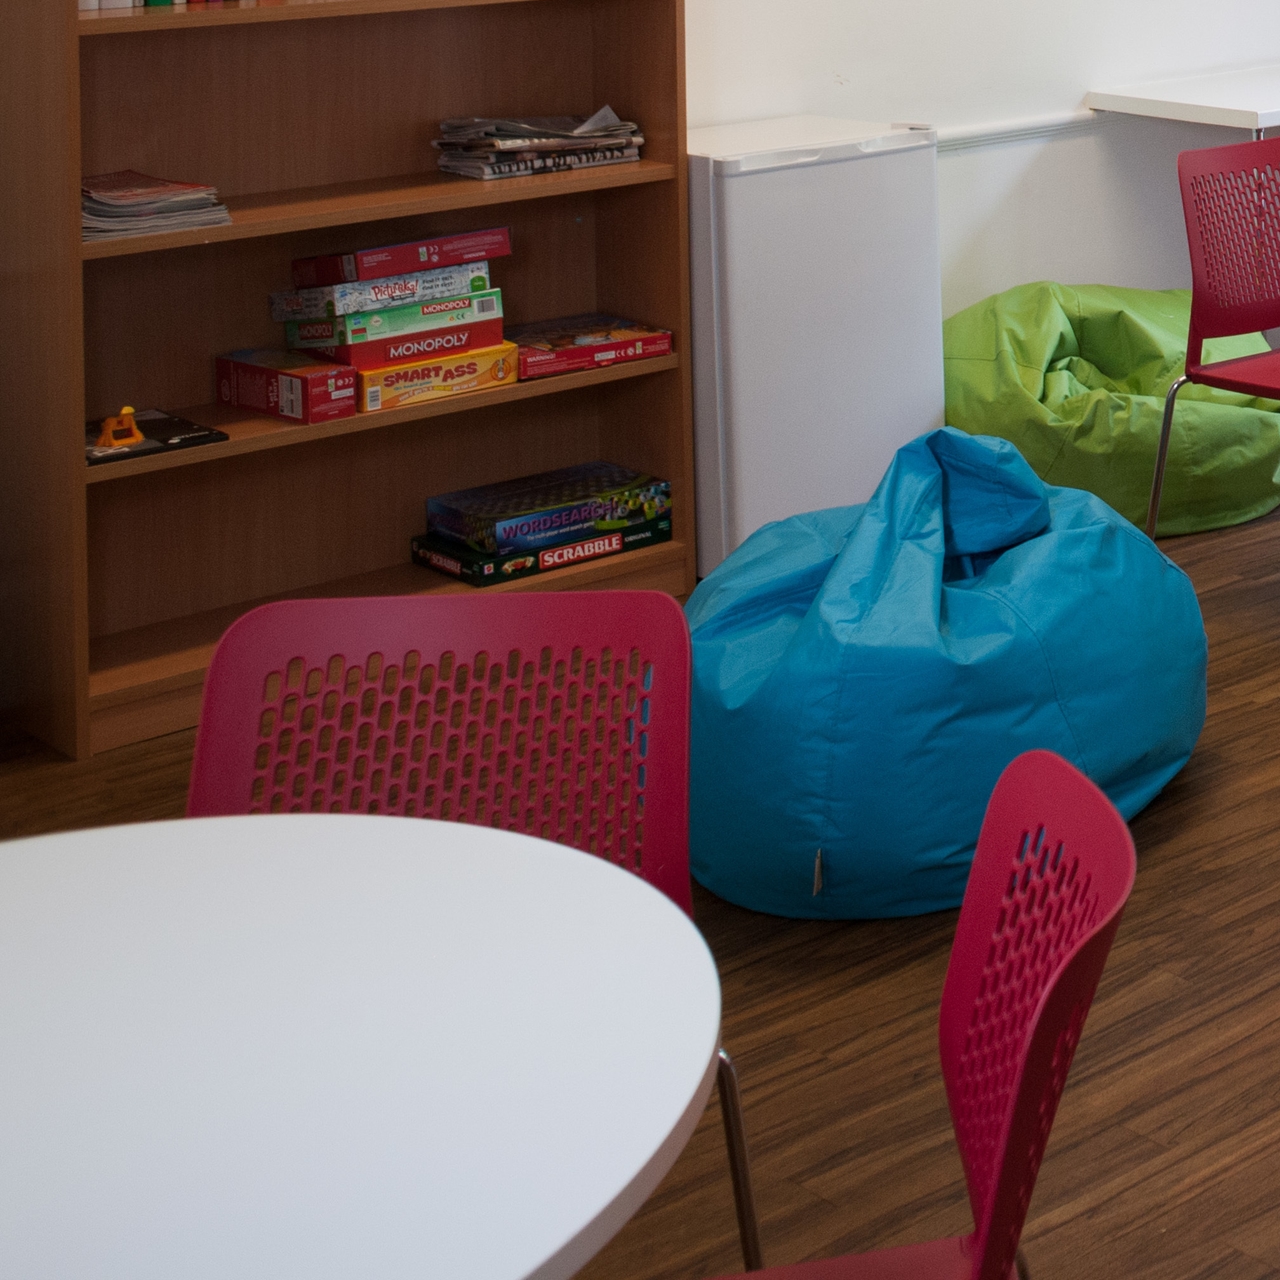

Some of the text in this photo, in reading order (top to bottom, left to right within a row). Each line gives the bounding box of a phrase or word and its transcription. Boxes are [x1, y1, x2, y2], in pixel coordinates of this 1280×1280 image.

[423, 299, 470, 314] MONOPOLY
[389, 333, 469, 359] MONOPOLY
[527, 352, 557, 363] WARNING!
[383, 362, 478, 389] SMART ASS
[501, 499, 618, 540] WORDSEARCH!
[431, 552, 461, 572] SCRABBLE
[542, 534, 621, 566] SCRABBLE
